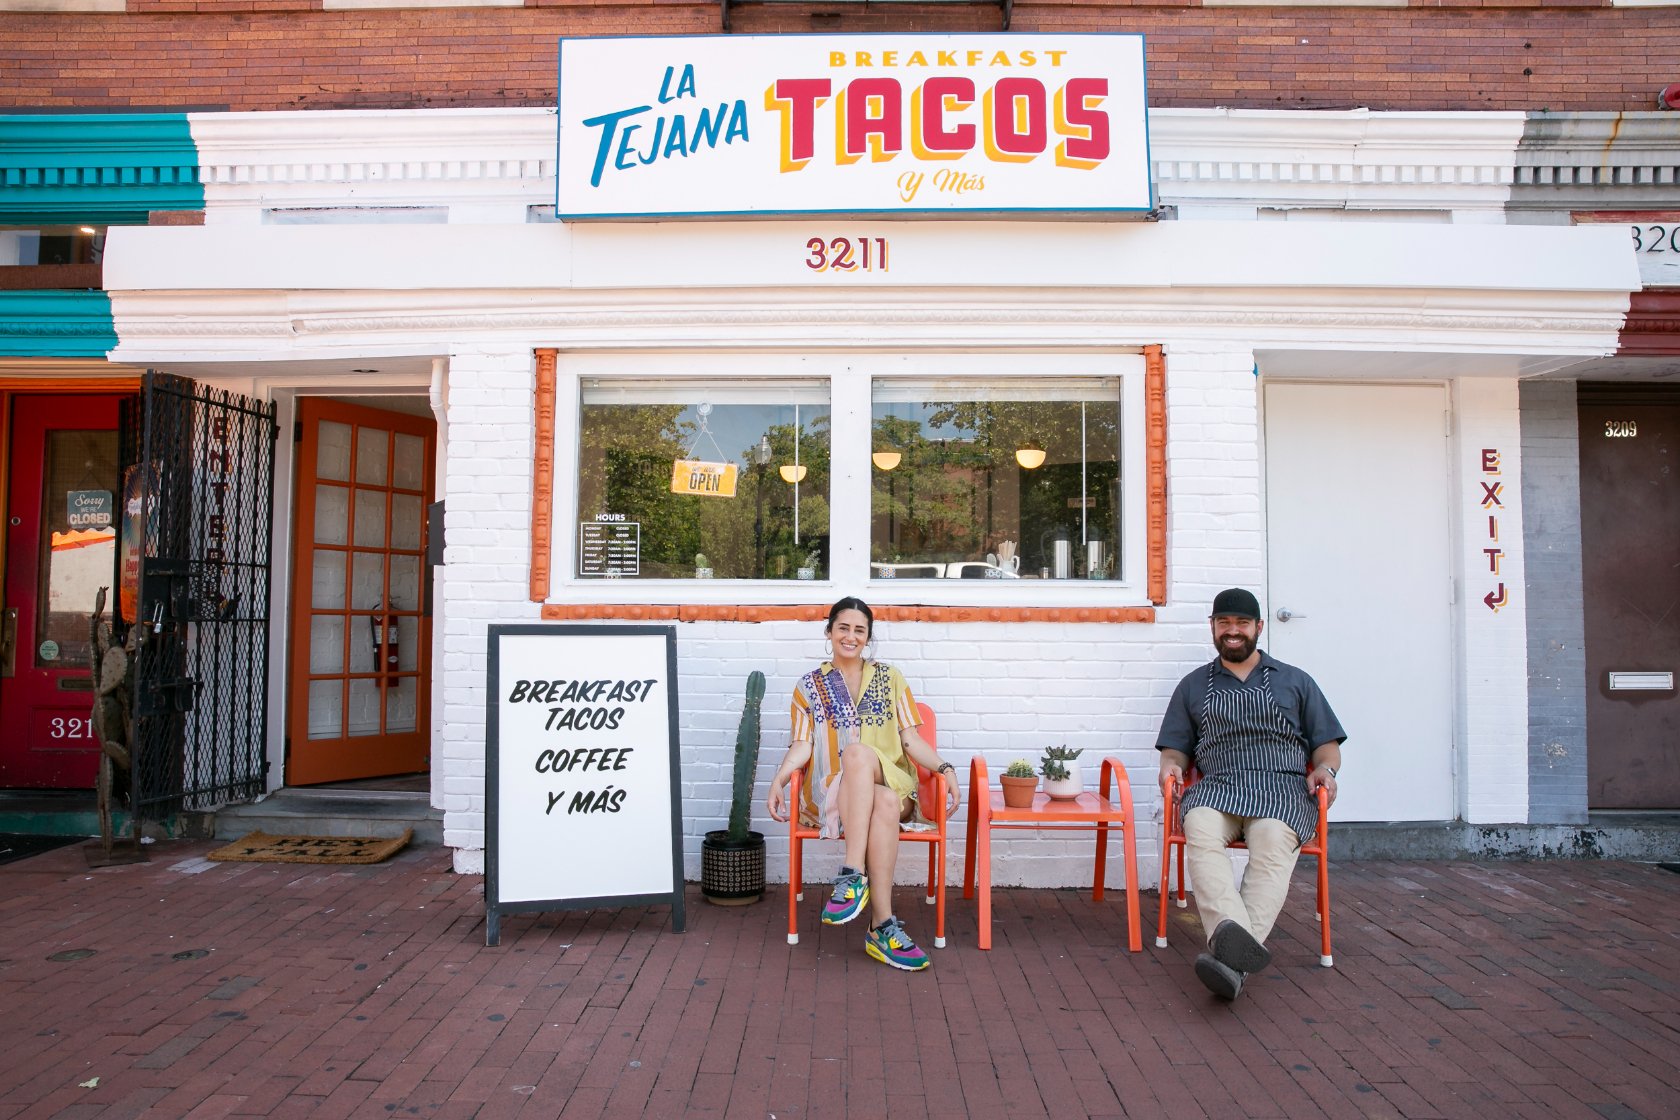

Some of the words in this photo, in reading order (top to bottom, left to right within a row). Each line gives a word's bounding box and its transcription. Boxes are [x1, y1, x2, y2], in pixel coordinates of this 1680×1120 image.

[829, 50, 1068, 68] BREAKFAST
[658, 64, 697, 104] LA
[764, 76, 1110, 175] TACOS
[582, 99, 750, 188] TEJANA
[933, 168, 985, 194] Más
[806, 237, 889, 272] 3211
[1605, 420, 1637, 438] 3209
[690, 473, 720, 491] OPEN
[74, 493, 105, 510] Sorry
[1480, 448, 1505, 576] EXIT
[70, 512, 111, 525] CLOSED
[595, 513, 626, 522] HOURS
[509, 679, 658, 704] BREAKFAST
[545, 707, 625, 731] TACOS
[535, 747, 634, 774] COFFEE
[545, 790, 565, 815] Y
[567, 785, 627, 815] MÁS
[270, 838, 383, 847] HEY
